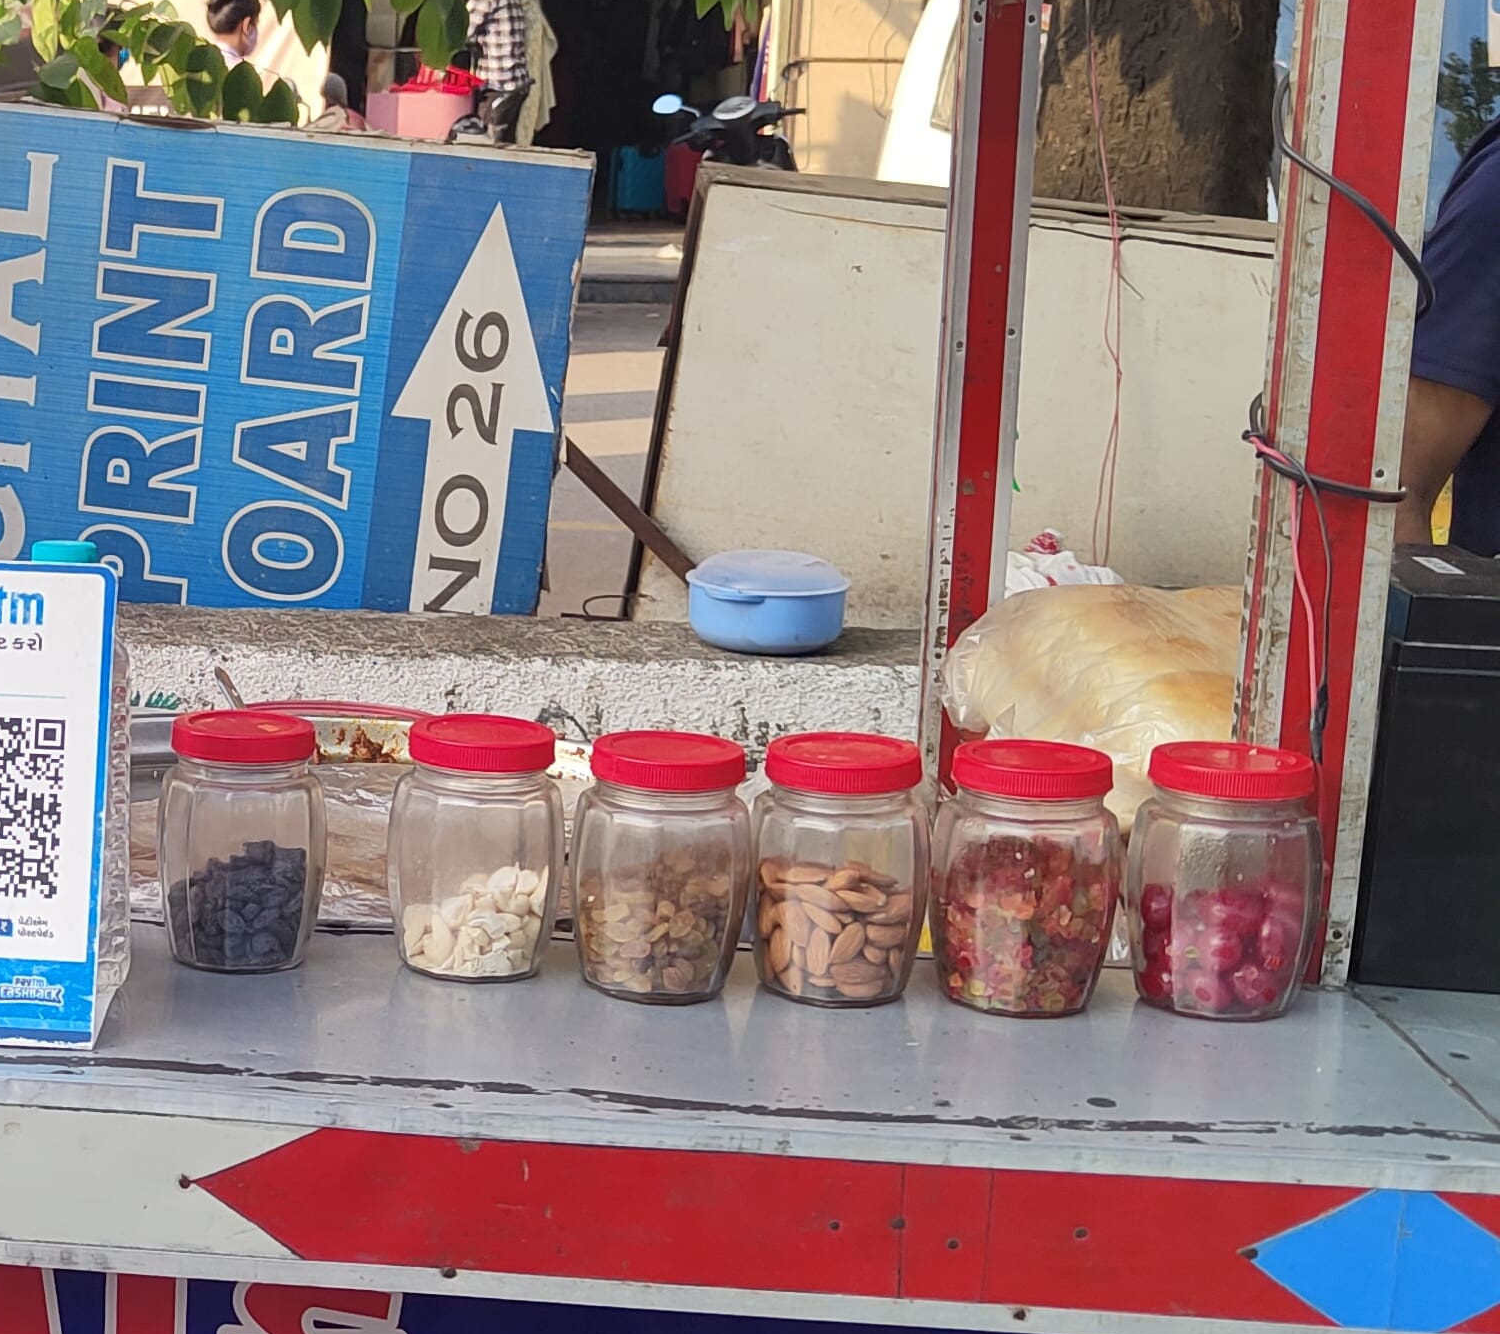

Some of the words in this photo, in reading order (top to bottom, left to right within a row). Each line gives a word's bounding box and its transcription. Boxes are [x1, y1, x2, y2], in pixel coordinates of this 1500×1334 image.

[222, 186, 377, 603] OARD
[444, 308, 511, 446] 26
[426, 474, 492, 614] NO
[12, 632, 43, 652] કરો
